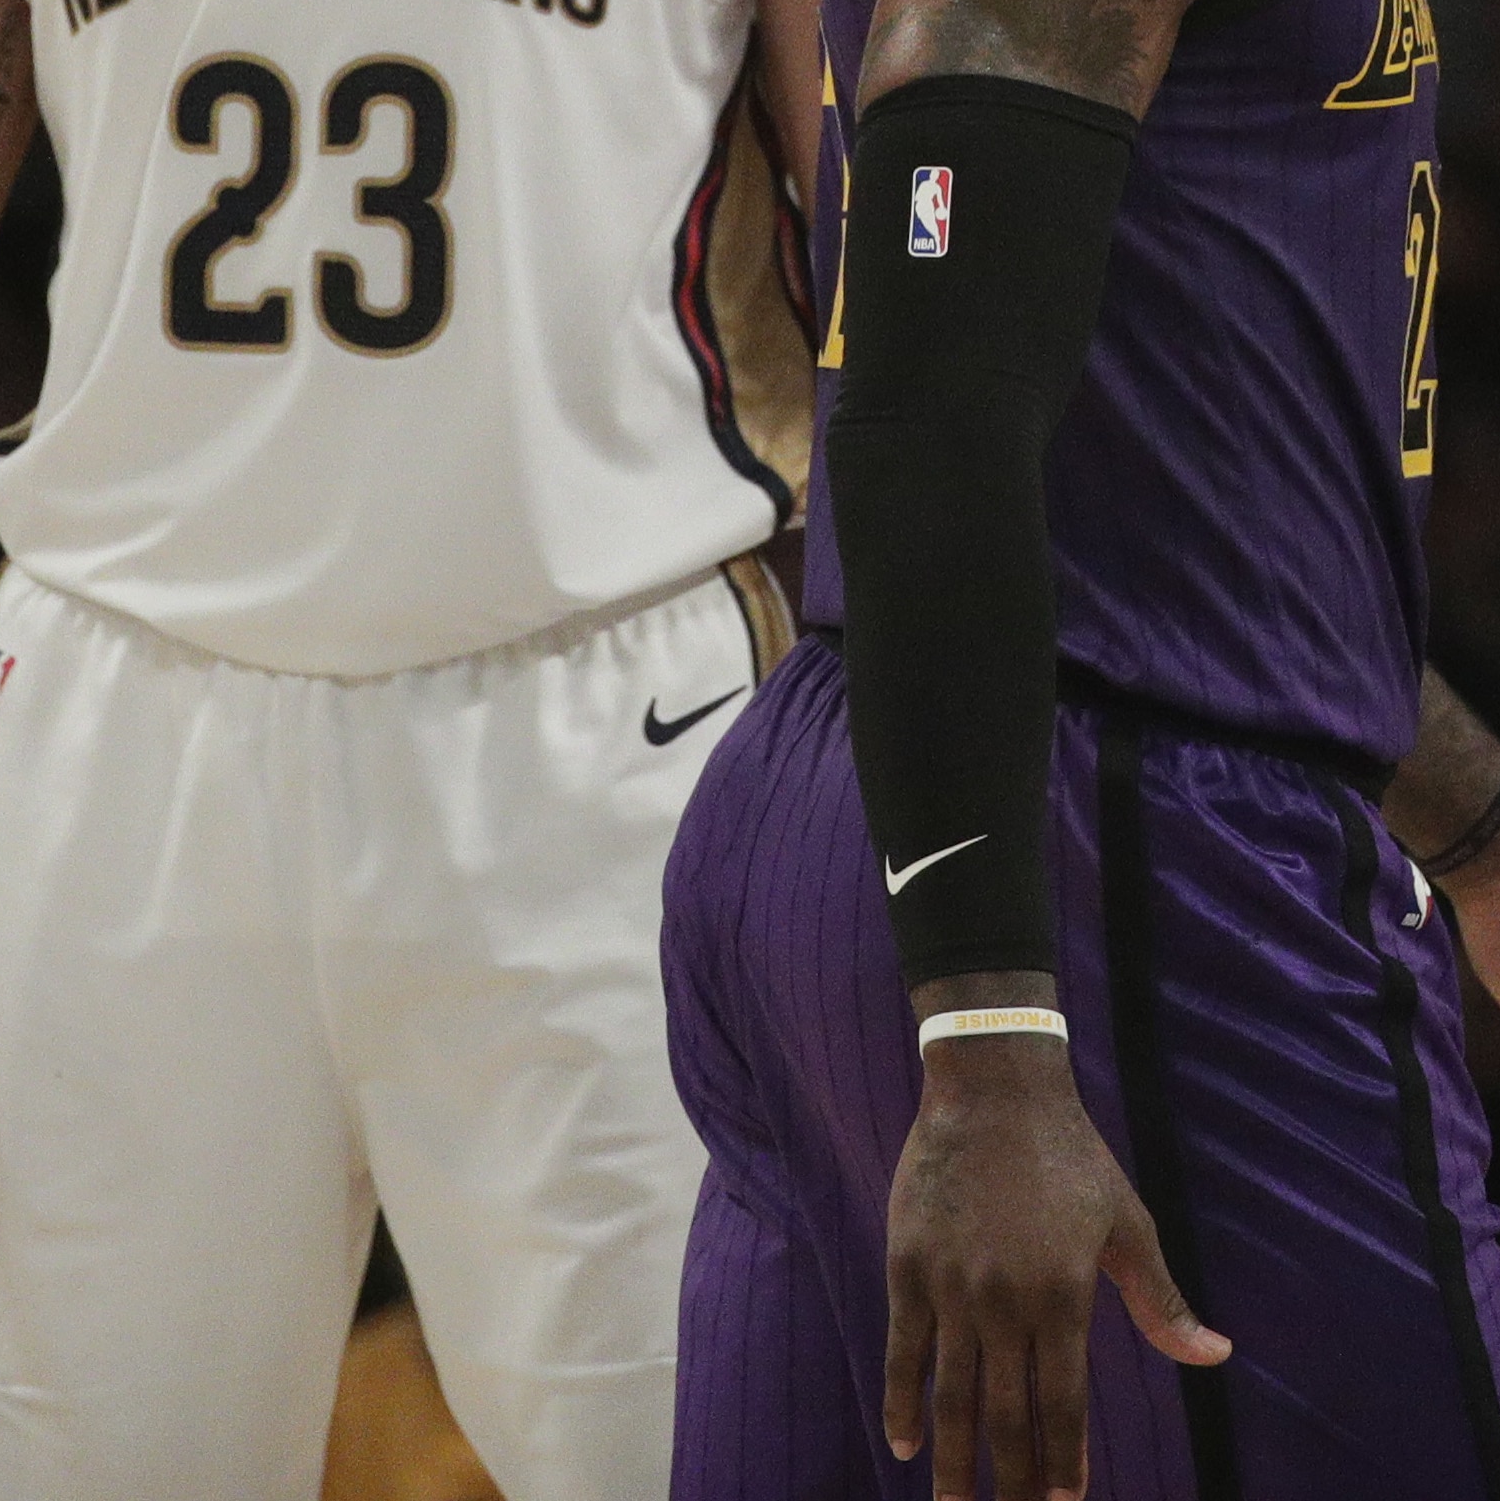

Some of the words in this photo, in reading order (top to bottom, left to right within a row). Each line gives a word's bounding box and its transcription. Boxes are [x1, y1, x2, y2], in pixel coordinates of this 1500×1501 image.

[163, 51, 456, 358] 23
[913, 237, 936, 251] NBA
[955, 1012, 1052, 1029] PROMISE
